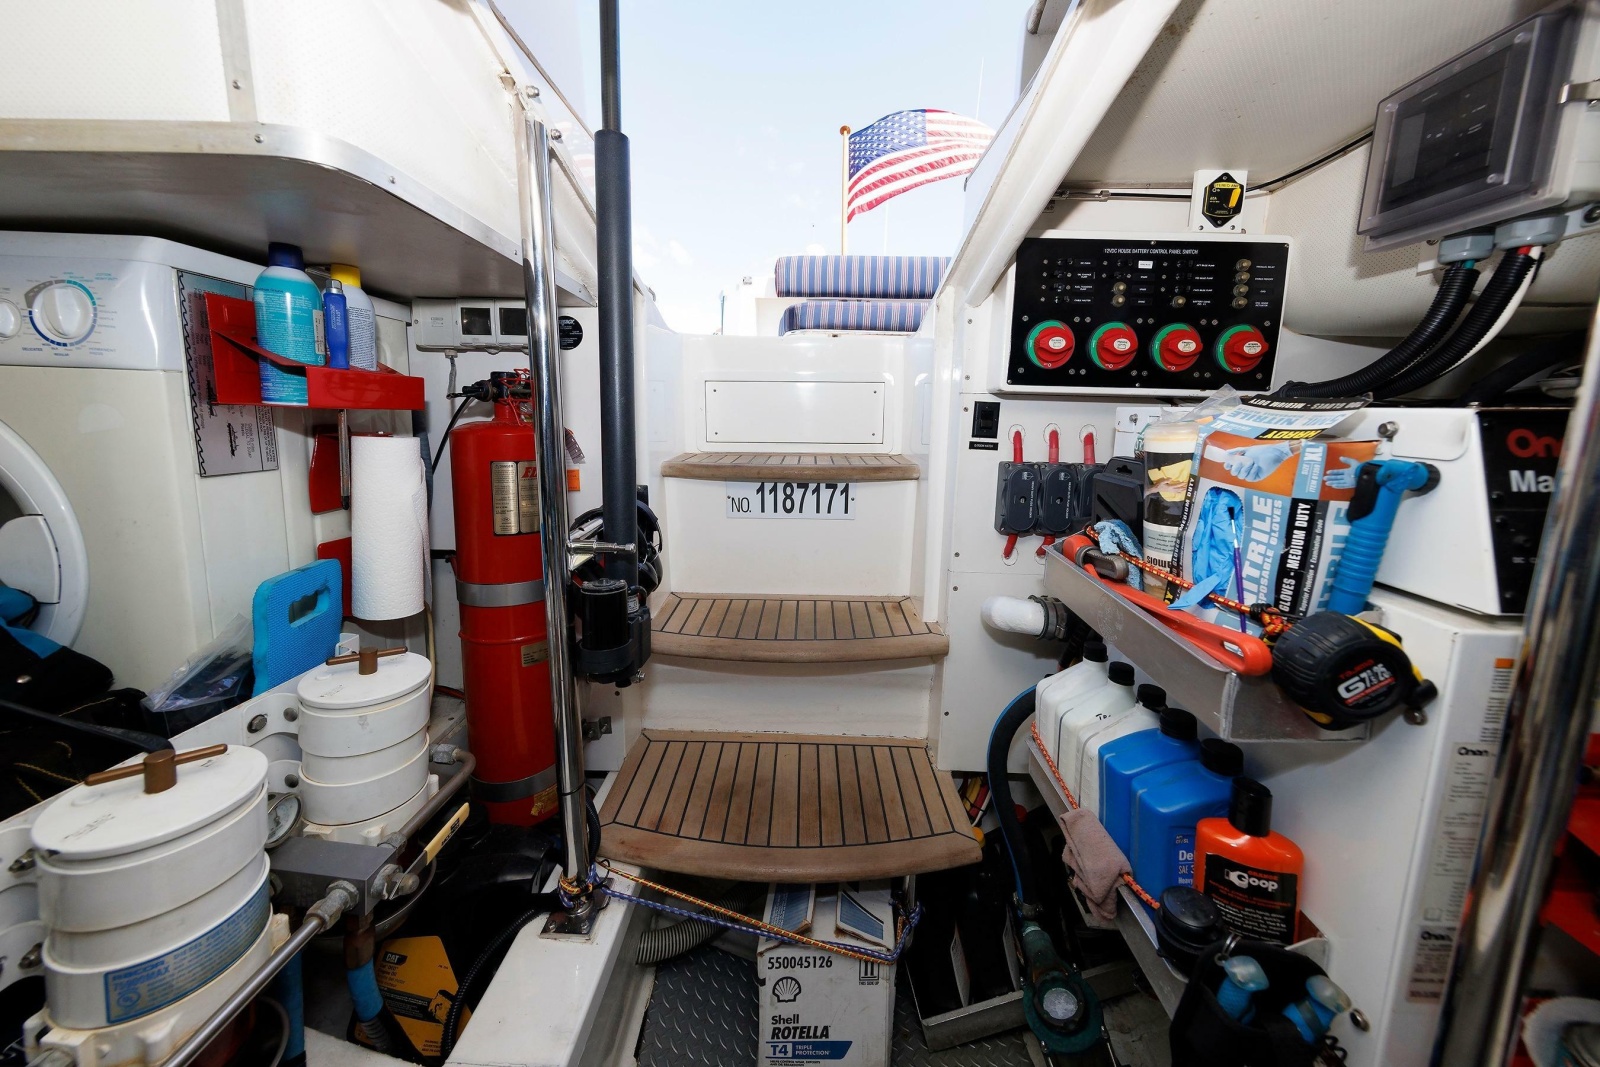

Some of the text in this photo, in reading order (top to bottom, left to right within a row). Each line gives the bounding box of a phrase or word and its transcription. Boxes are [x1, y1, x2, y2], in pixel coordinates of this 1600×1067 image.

[1262, 429, 1322, 440] HARDY
[1304, 444, 1324, 462] XL
[731, 481, 850, 514] NO. 1187171
[1268, 499, 1284, 546] GLOVES
[1278, 502, 1312, 613] GLOVES MEDIUM DUTY
[385, 953, 400, 963] CAT
[767, 956, 833, 970] 550045126
[771, 1014, 800, 1025] Shell
[770, 1025, 830, 1040] ROTELLA
[770, 1044, 789, 1056] T4
